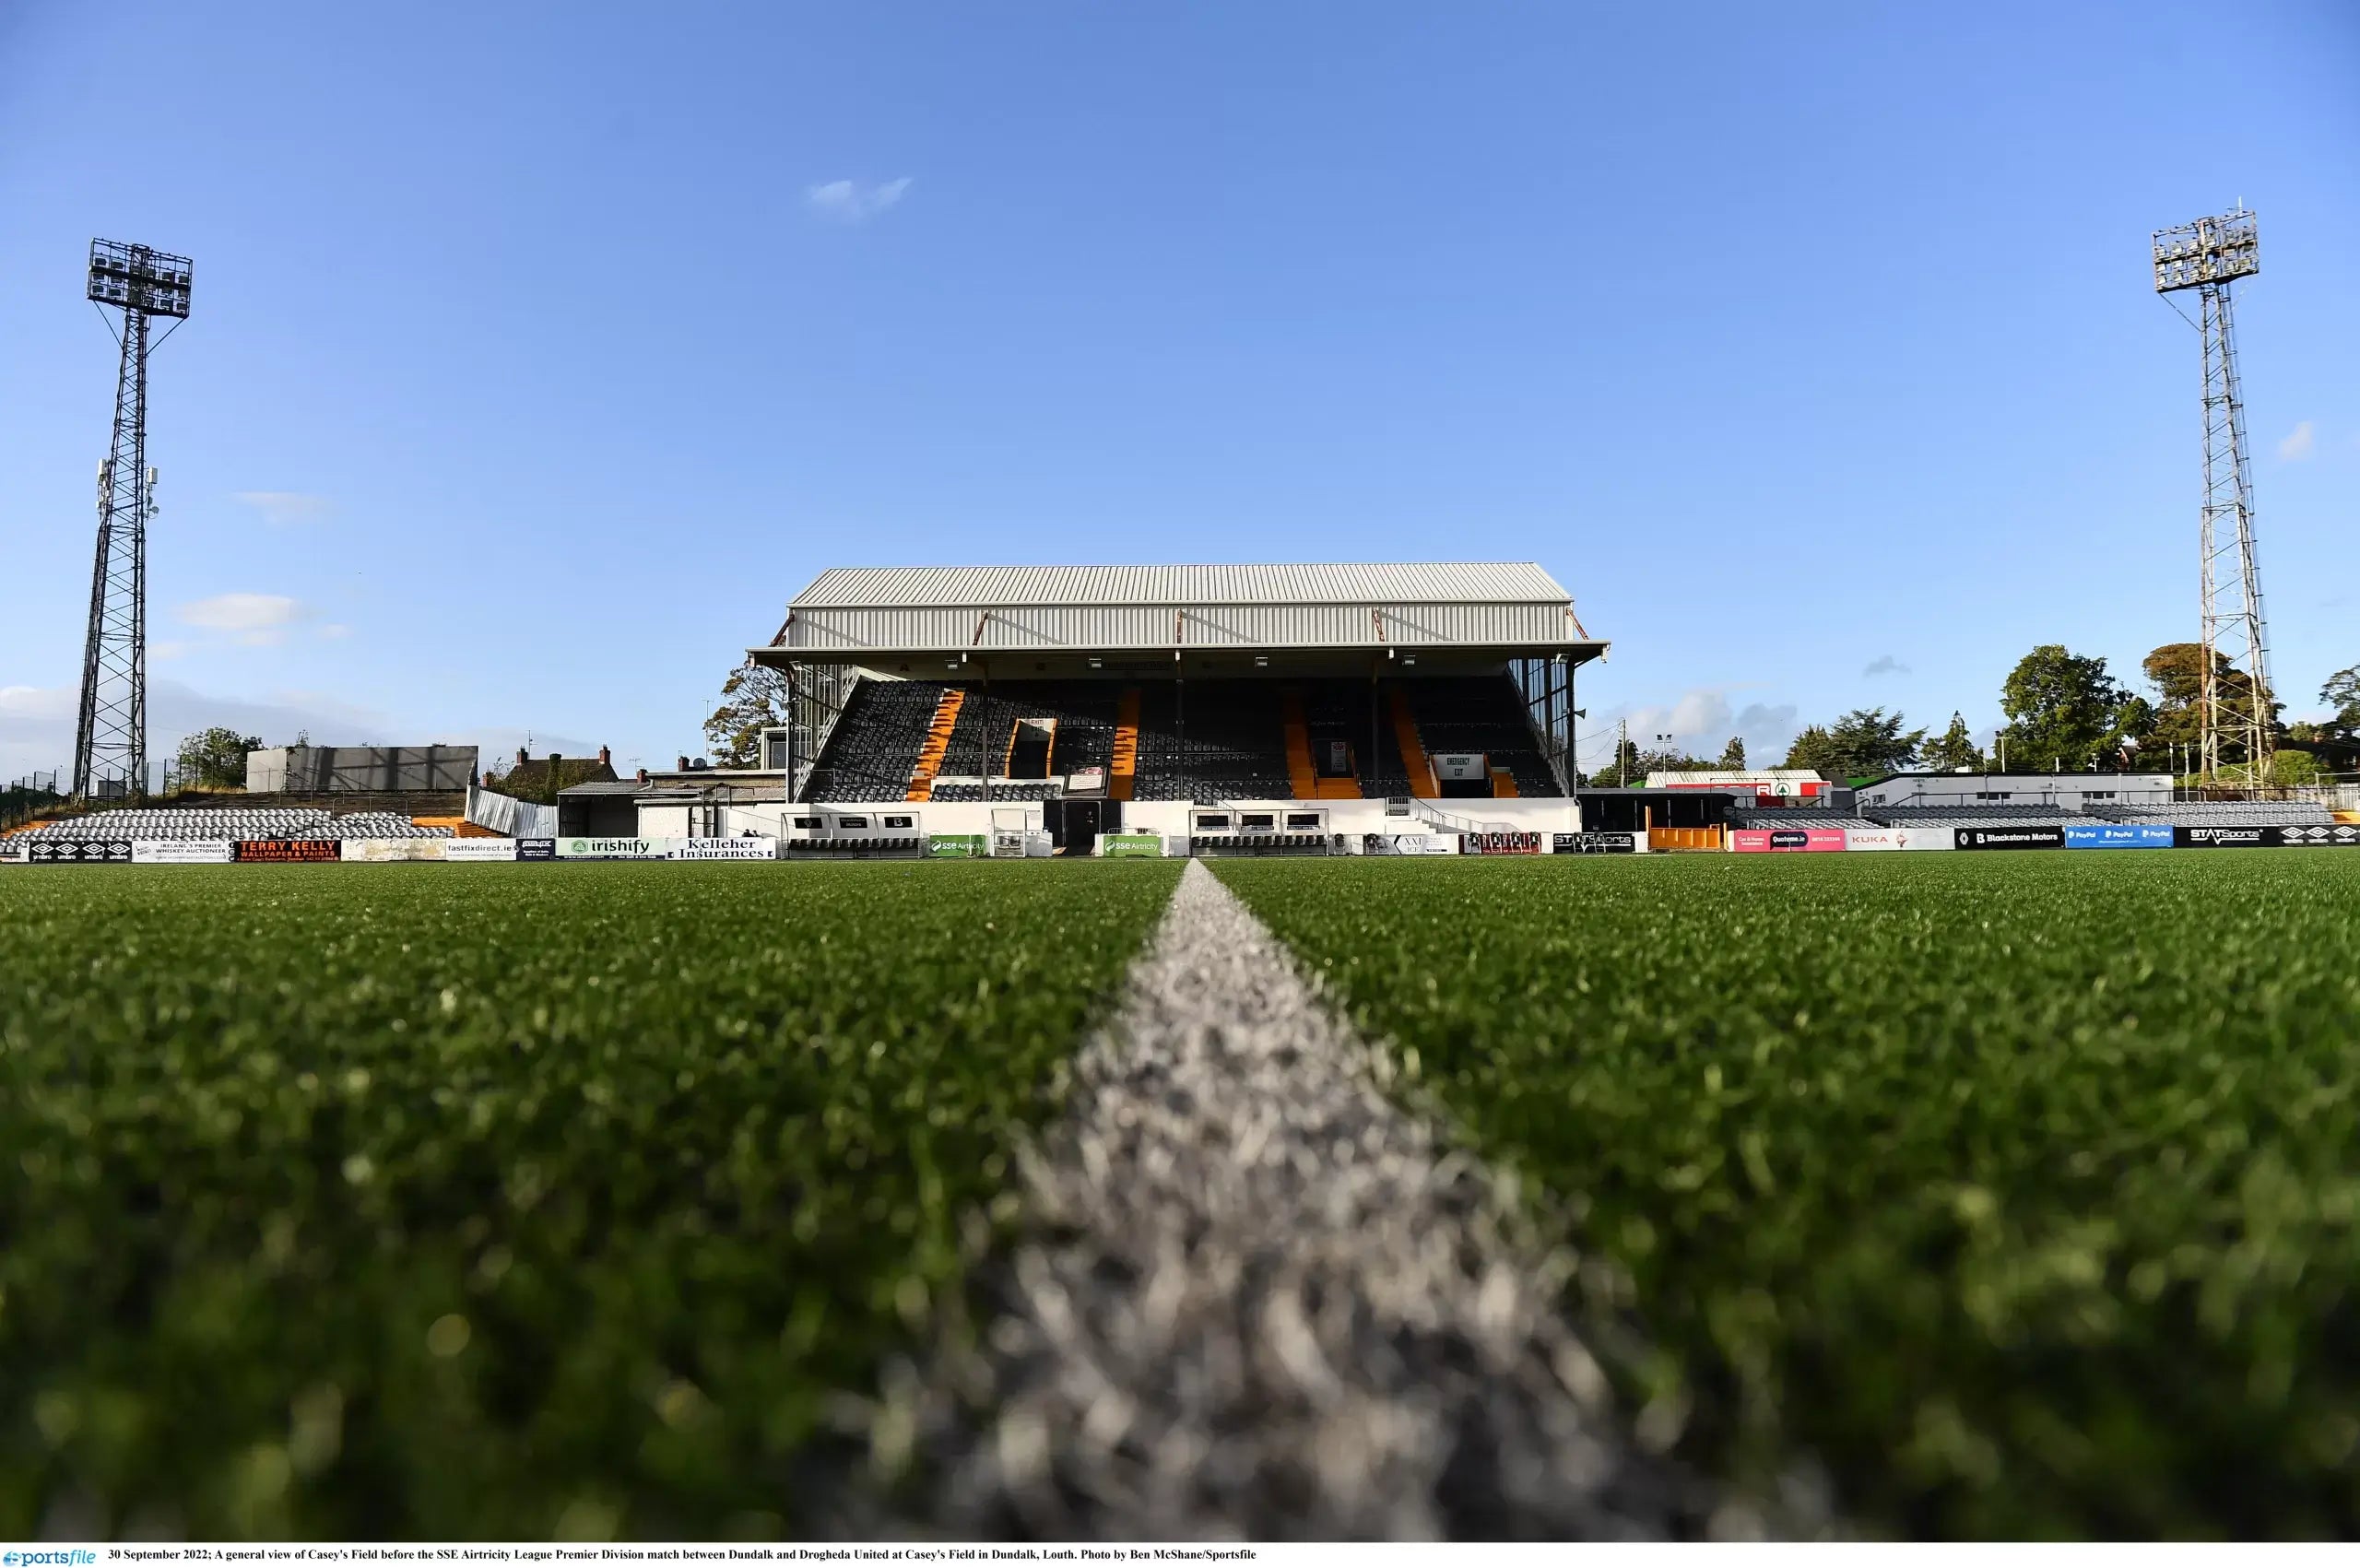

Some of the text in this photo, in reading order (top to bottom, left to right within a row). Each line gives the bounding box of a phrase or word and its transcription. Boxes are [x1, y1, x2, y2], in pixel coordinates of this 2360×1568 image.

[1446, 757, 1469, 766] EMERGENCY
[1454, 768, 1464, 777] EXIT
[1987, 832, 2059, 842] Blackstone Motors
[2190, 828, 2260, 840] STATSports
[240, 841, 336, 851] TERRY KELLY
[687, 839, 756, 849] Kelleher
[1404, 837, 1422, 845] XXI
[592, 840, 650, 854] irishify
[1131, 843, 1159, 852] Airtricity
[678, 848, 764, 858] Insurances
